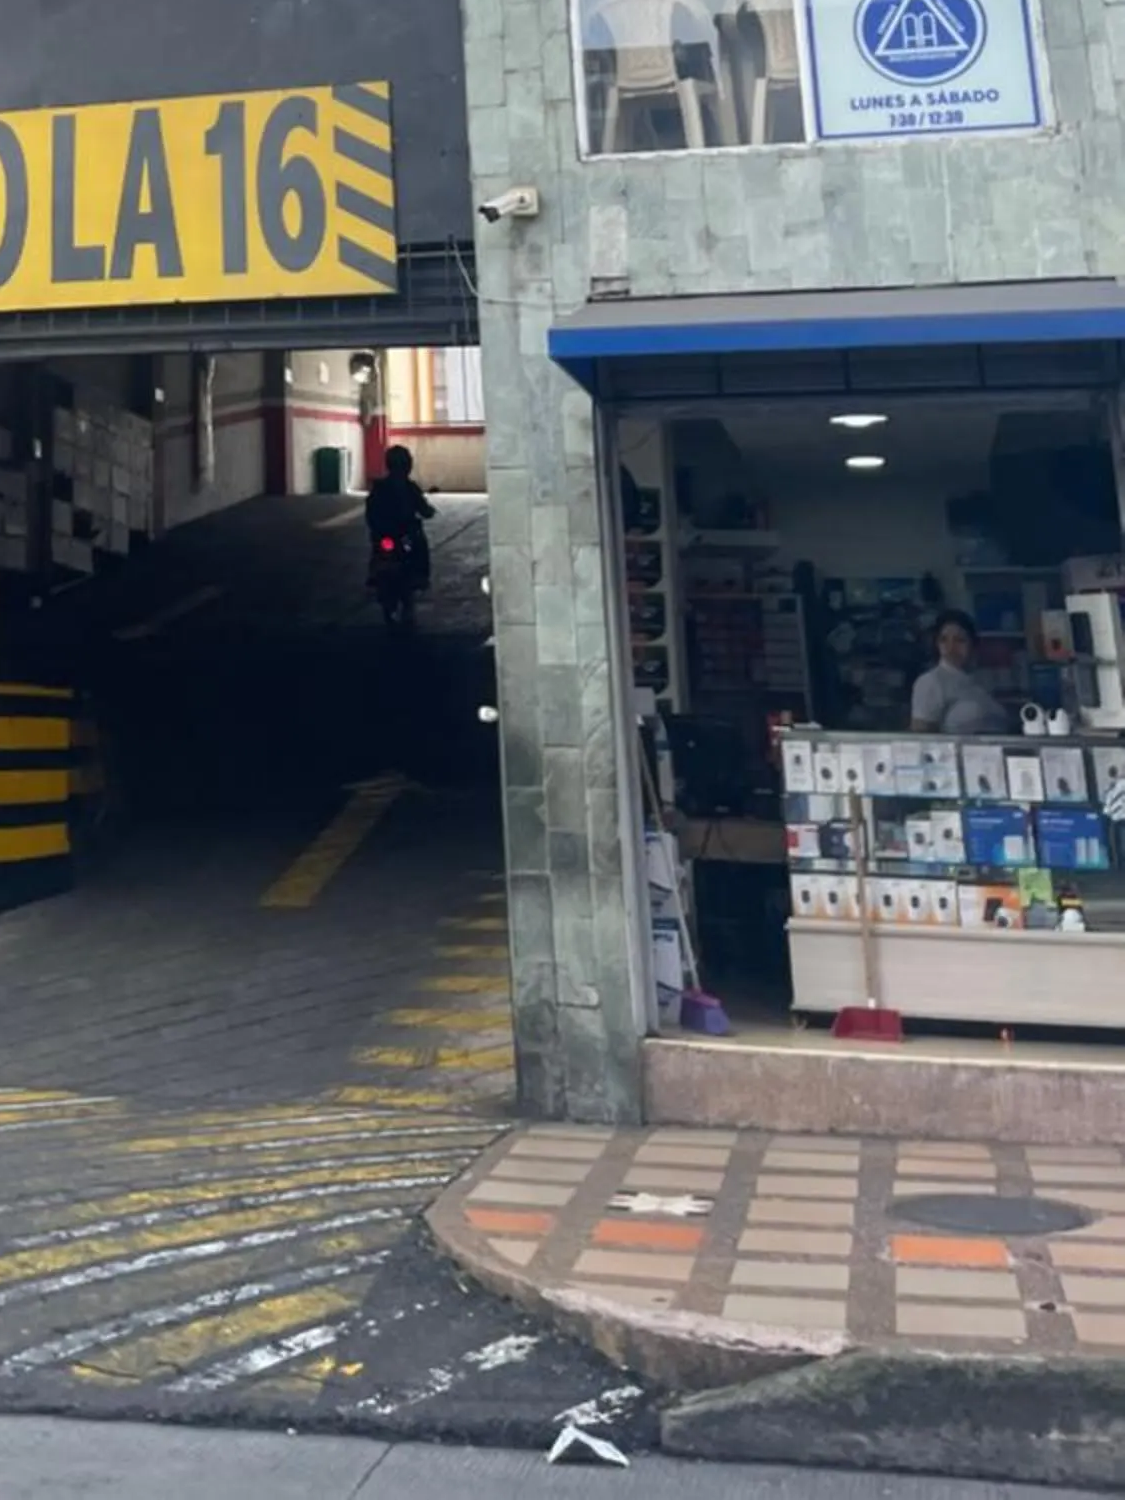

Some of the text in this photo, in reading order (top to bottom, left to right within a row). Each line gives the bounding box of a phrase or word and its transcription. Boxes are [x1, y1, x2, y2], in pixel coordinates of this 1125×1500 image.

[850, 94, 906, 111] LUNES
[909, 94, 922, 107] A
[50, 107, 185, 284] LA
[204, 95, 327, 275] 16
